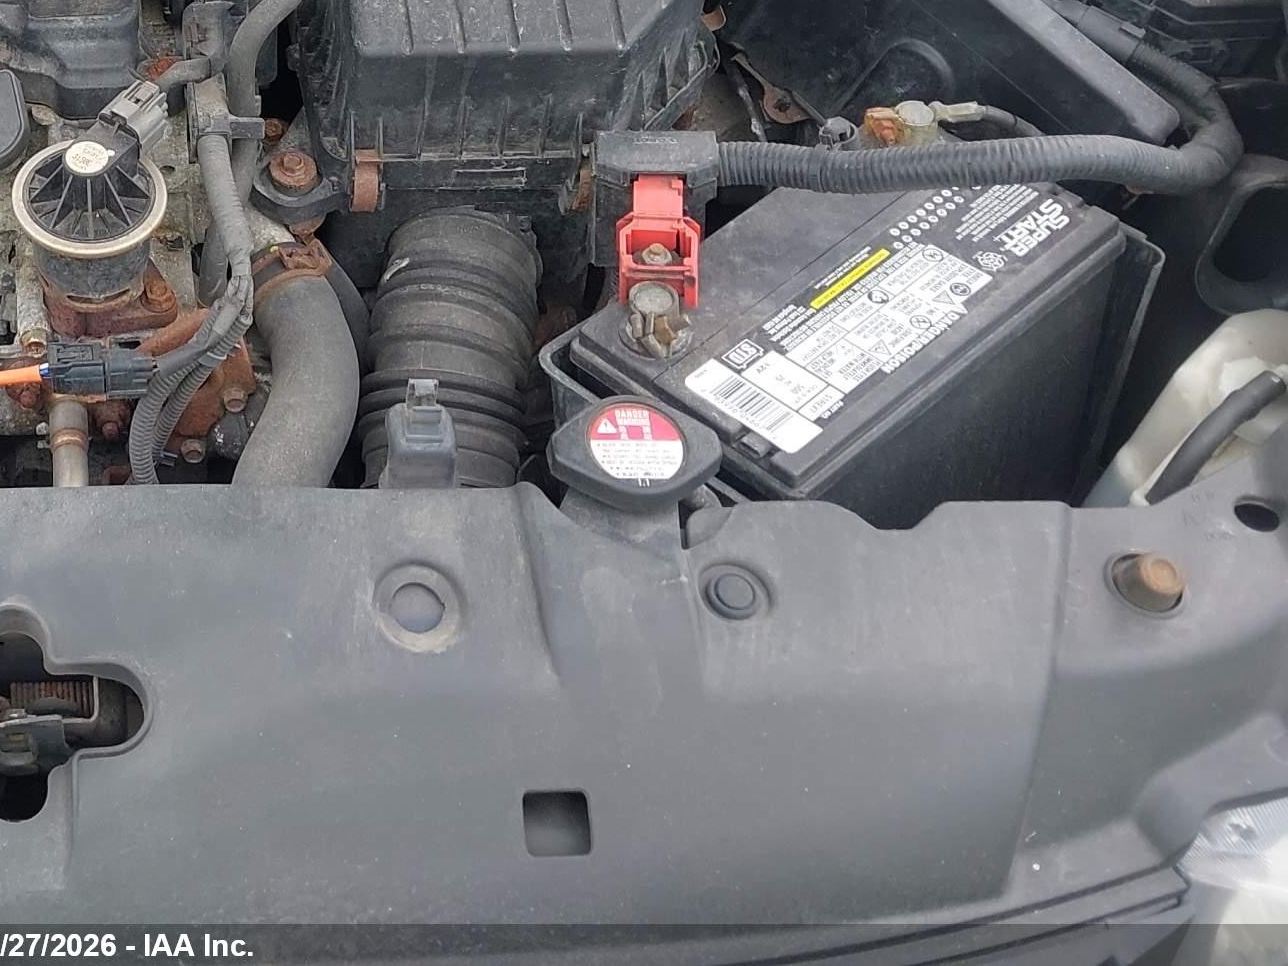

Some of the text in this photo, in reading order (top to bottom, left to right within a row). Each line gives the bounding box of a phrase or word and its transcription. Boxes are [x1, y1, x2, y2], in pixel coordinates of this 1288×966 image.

[999, 198, 1064, 249] START
[1007, 214, 1070, 257] SUPER
[726, 341, 759, 365] STD
[881, 311, 961, 374] DANGER/POISON
